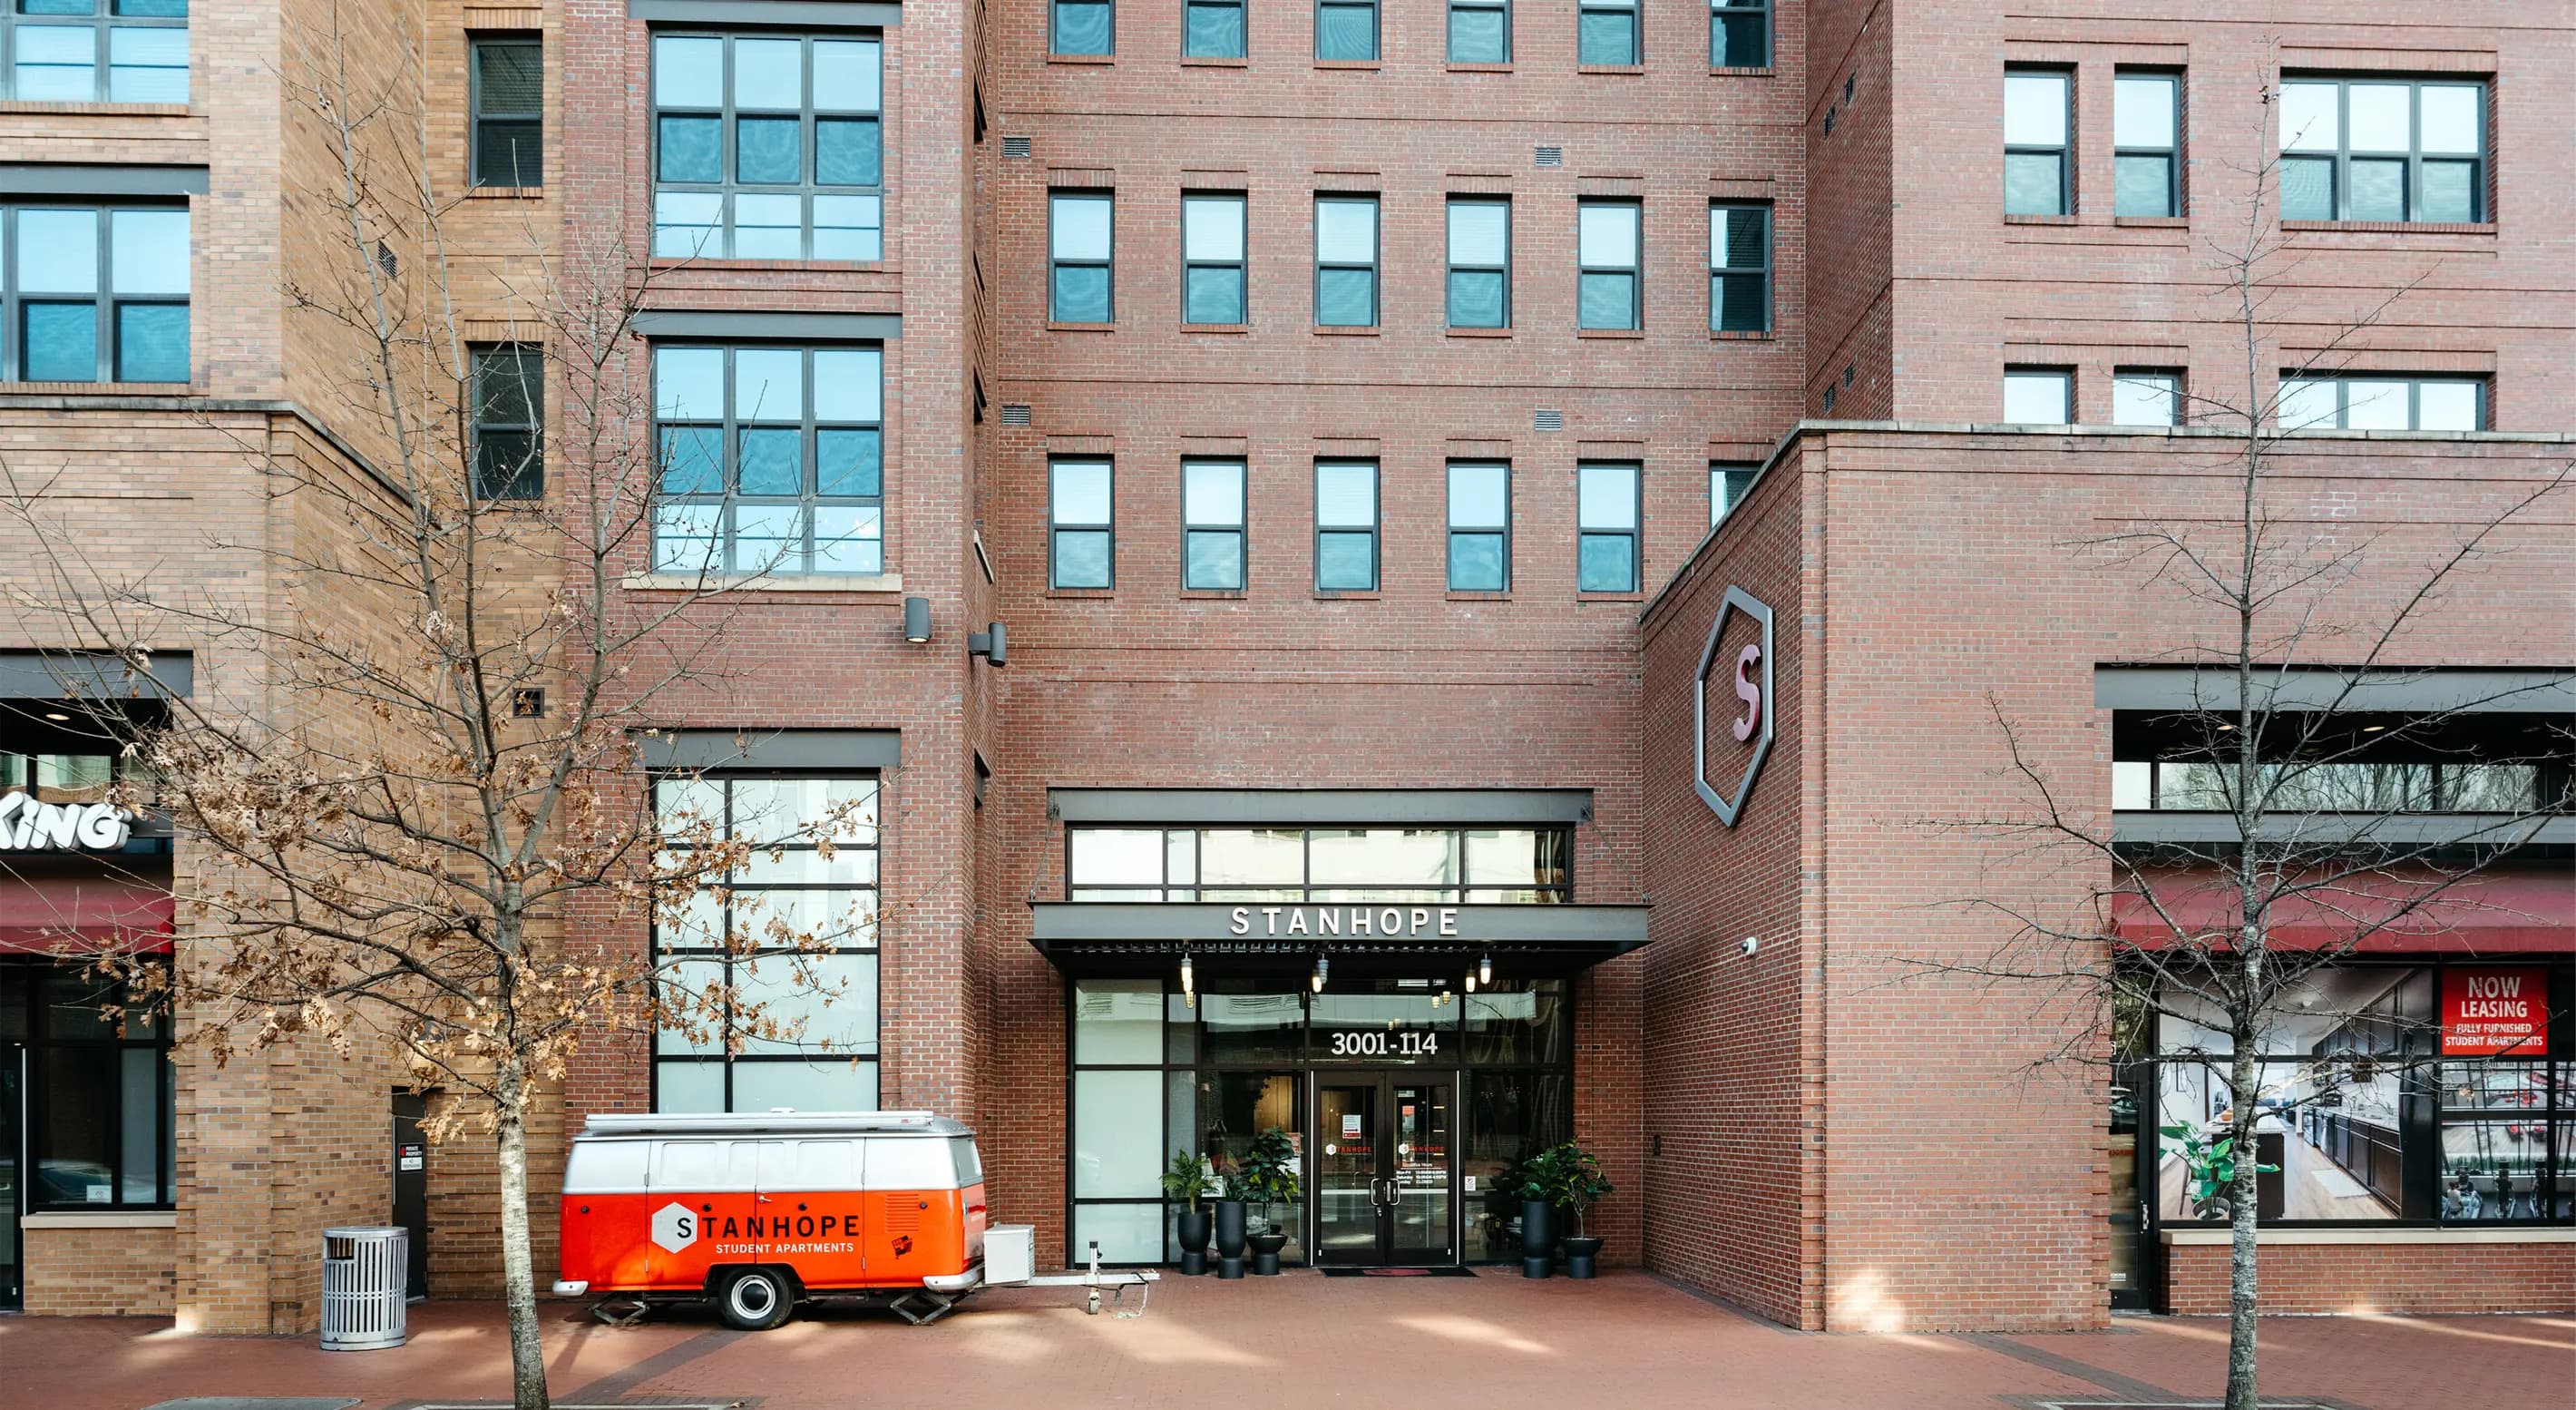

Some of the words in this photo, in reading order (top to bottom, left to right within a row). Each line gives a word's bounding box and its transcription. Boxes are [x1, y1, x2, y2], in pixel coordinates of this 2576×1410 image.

[1733, 644, 1761, 741] S
[1230, 907, 1459, 935] STANHOPE
[2468, 977, 2521, 998] NOW
[2461, 1001, 2528, 1018] LEASING
[2456, 1023, 2481, 1033] FULLY
[2483, 1023, 2532, 1033] FURNISHED
[1331, 1033, 1439, 1054] 3001-114
[2445, 1036, 2484, 1046] STUDENT
[2486, 1036, 2543, 1046] APARTMENTS
[677, 1215, 860, 1239] STANHOPE
[716, 1244, 771, 1254] STUDENT
[776, 1242, 854, 1253] APARTMENTS
